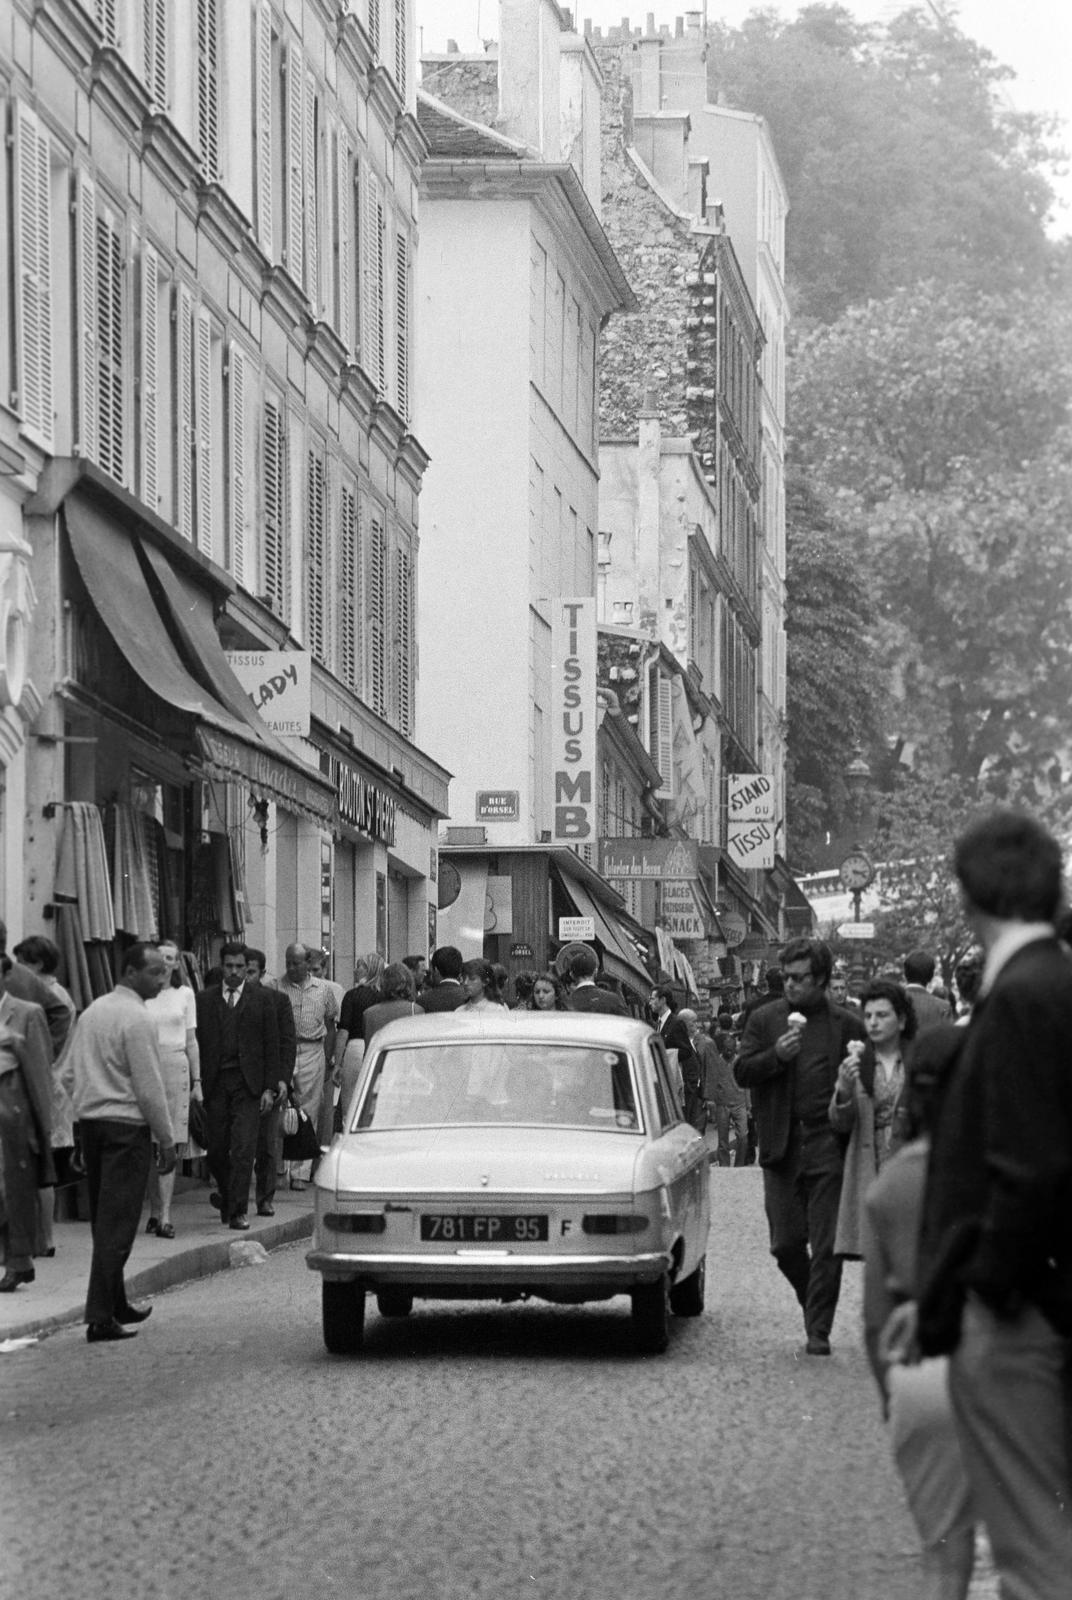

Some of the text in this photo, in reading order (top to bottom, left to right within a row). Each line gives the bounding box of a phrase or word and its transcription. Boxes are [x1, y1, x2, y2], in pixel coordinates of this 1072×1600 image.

[226, 655, 265, 666] TISSUS
[263, 721, 302, 732] EAUTES
[555, 603, 592, 838] TISSUS MB
[488, 797, 507, 805] RUE
[730, 776, 771, 810] STAND
[754, 806, 769, 815] DU
[728, 822, 771, 857] TISSU
[664, 917, 700, 933] SNACK
[429, 1216, 540, 1240] 781 FP 95
[561, 1219, 572, 1237] F
